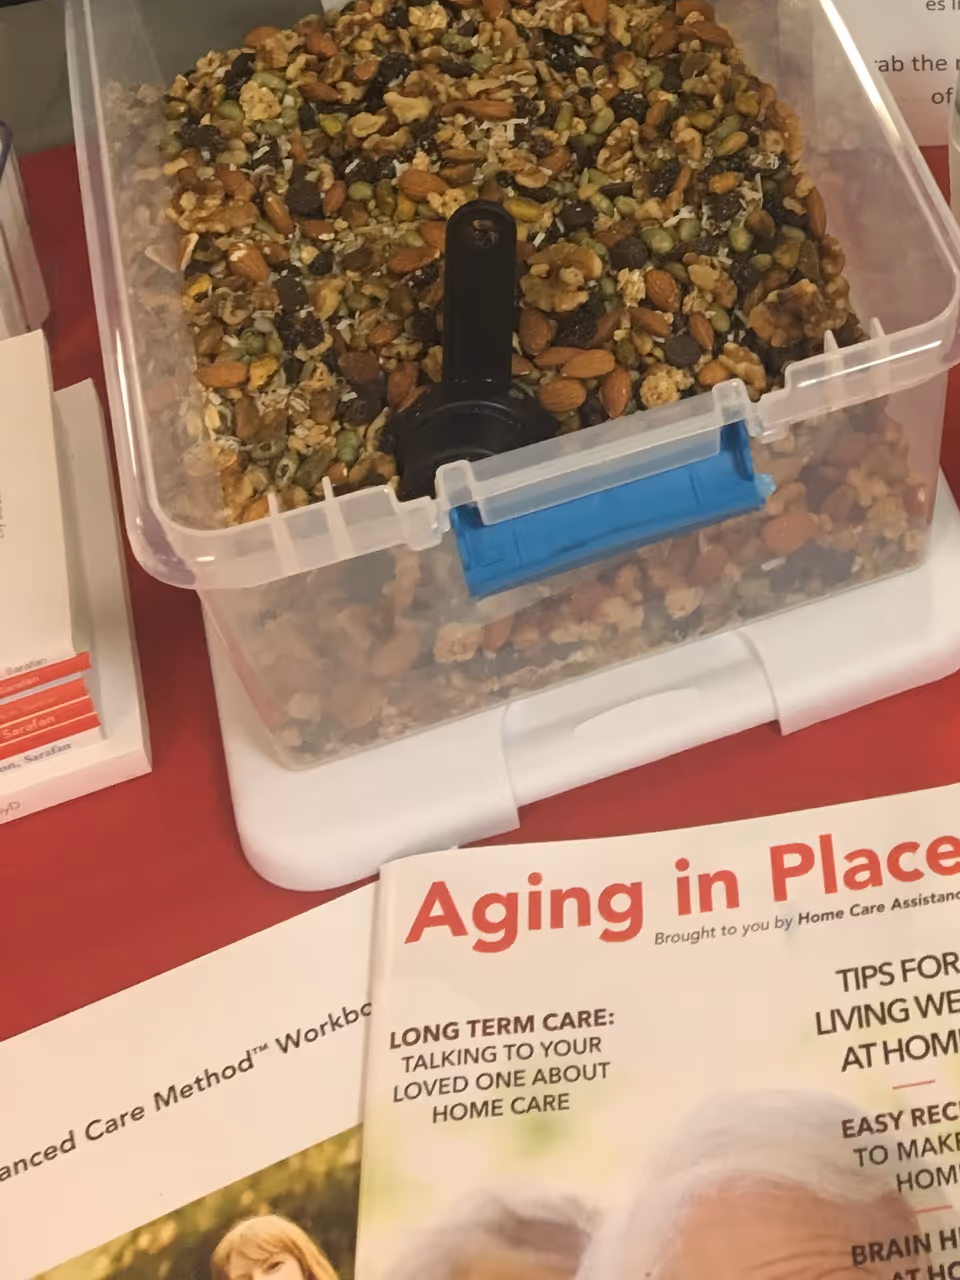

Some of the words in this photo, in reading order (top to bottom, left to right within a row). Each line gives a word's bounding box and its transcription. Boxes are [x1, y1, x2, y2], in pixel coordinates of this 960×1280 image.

[926, 0, 945, 11] es
[911, 54, 947, 71] the
[931, 87, 954, 104] of
[2, 715, 57, 739] Sarafan
[24, 742, 72, 763] Sarafan
[404, 873, 643, 953] Aging
[676, 858, 739, 916] in
[654, 925, 716, 945] Brought
[721, 924, 737, 937] to
[742, 920, 771, 937] you
[774, 915, 794, 931] by
[798, 908, 845, 926] Home
[849, 901, 885, 917] Care
[835, 962, 895, 992] TIPS
[901, 952, 960, 982] FOR
[390, 1022, 459, 1050] LONG
[466, 1015, 534, 1037] TERM
[542, 1008, 614, 1031] CARE:
[815, 998, 910, 1036] LIVING
[401, 1046, 497, 1073] TALKING
[503, 1043, 534, 1060] TO
[540, 1037, 601, 1058] YOUR
[841, 1042, 877, 1072] AT
[393, 1076, 468, 1103] LOVED
[476, 1070, 526, 1090] ONE
[532, 1062, 611, 1085] ABOUT
[84, 1104, 145, 1141] Care
[433, 1099, 503, 1124] HOME
[511, 1093, 570, 1115] CARE
[841, 1110, 904, 1139] EASY
[853, 1145, 888, 1168] TO
[851, 1233, 931, 1267] BRAIN
